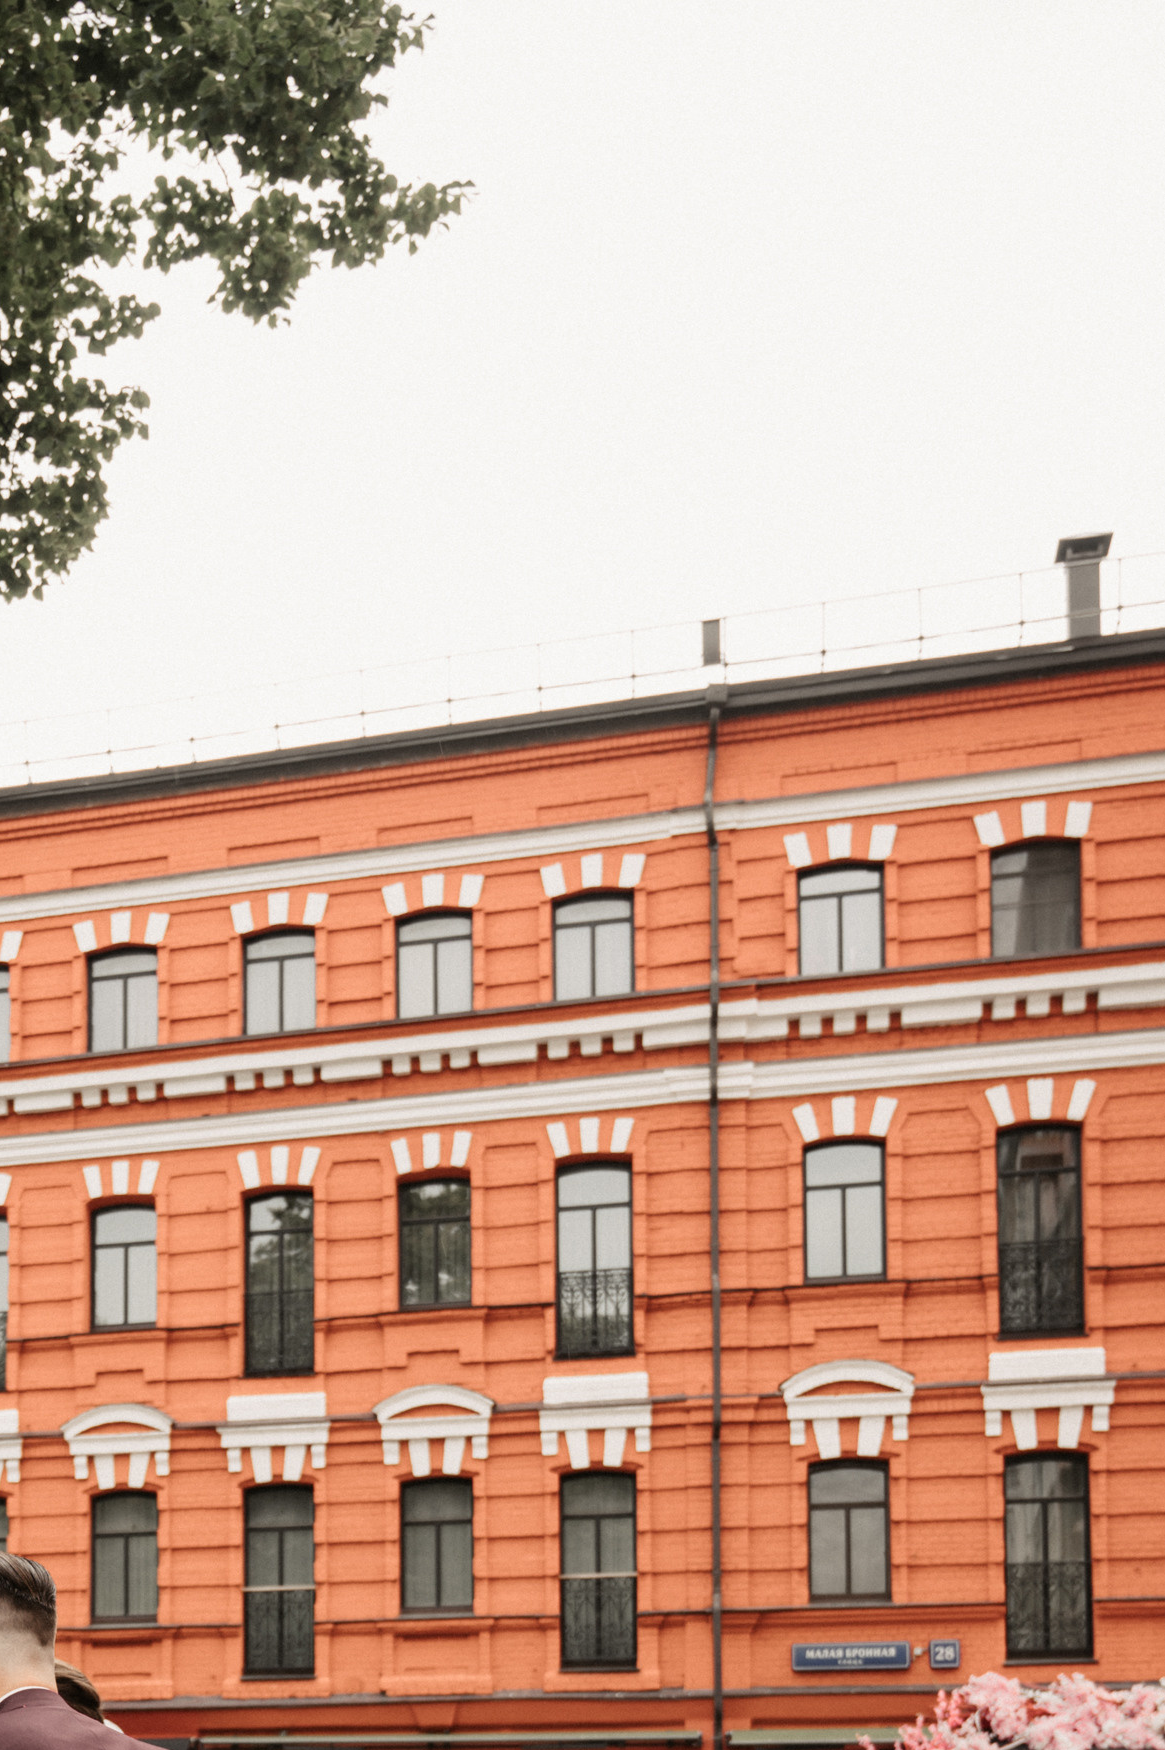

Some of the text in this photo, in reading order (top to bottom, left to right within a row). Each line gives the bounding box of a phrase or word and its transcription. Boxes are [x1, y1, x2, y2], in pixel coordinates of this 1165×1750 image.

[805, 1647, 896, 1659] МАЛАЯ БРОННАЯ
[934, 1646, 955, 1661] 28
